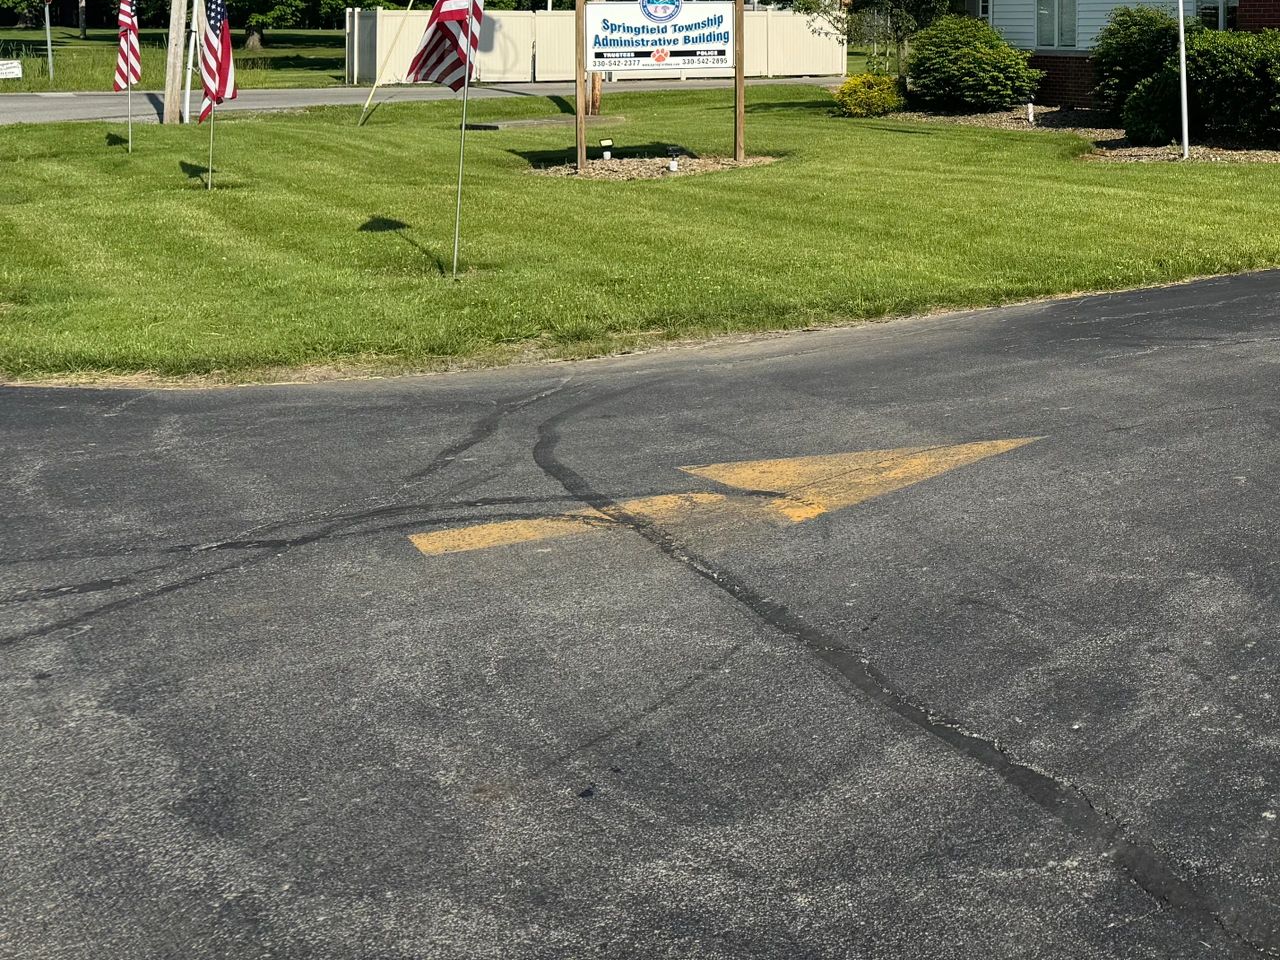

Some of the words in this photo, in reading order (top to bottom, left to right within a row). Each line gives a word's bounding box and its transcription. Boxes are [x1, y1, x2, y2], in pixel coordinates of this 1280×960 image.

[601, 18, 668, 36] Springfield
[671, 14, 724, 33] Township
[593, 34, 679, 47] Administrative
[683, 30, 730, 44] Building
[592, 59, 641, 67] 330-542-2377
